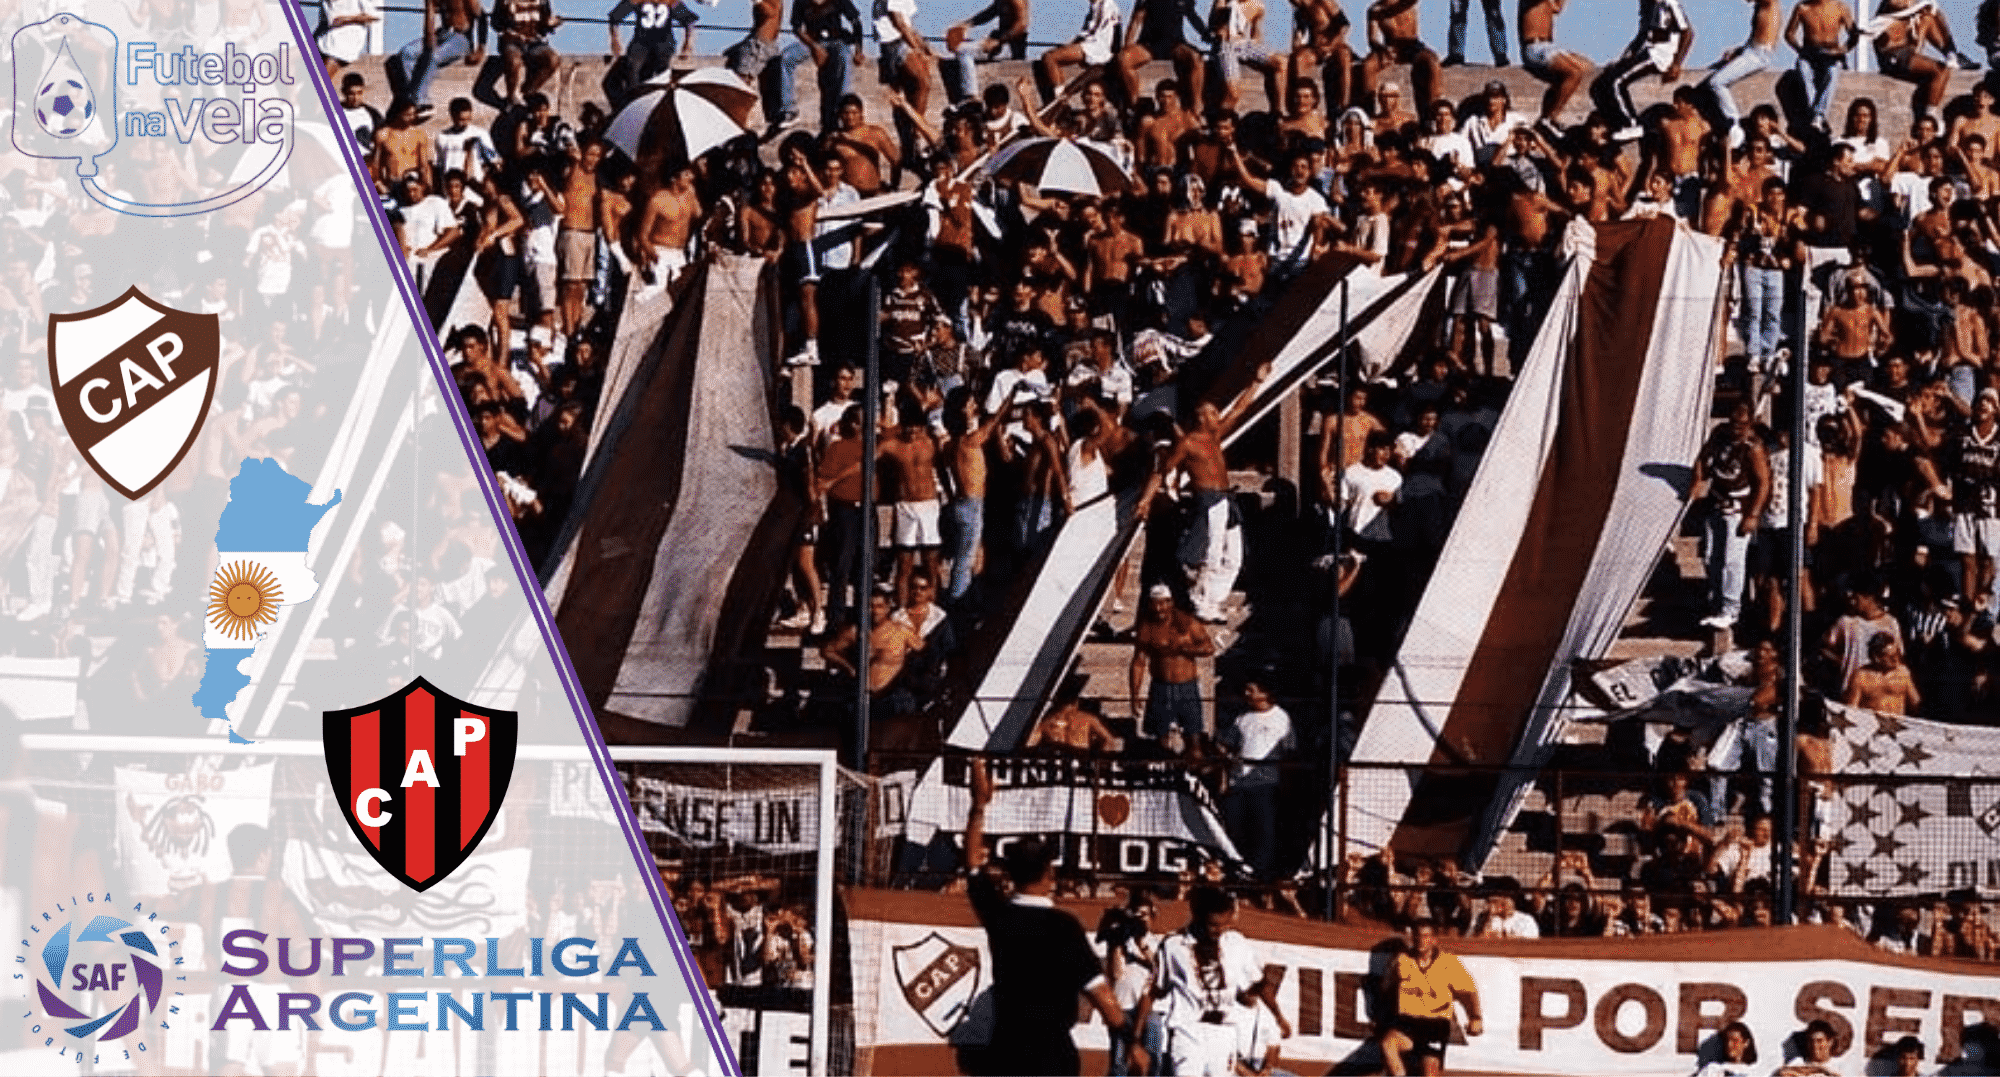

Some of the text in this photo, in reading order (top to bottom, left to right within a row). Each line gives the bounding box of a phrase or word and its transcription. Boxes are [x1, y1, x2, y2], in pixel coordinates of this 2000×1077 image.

[754, 799, 800, 844] UN
[915, 953, 960, 1000] CAP
[1518, 975, 1748, 1055] POR
